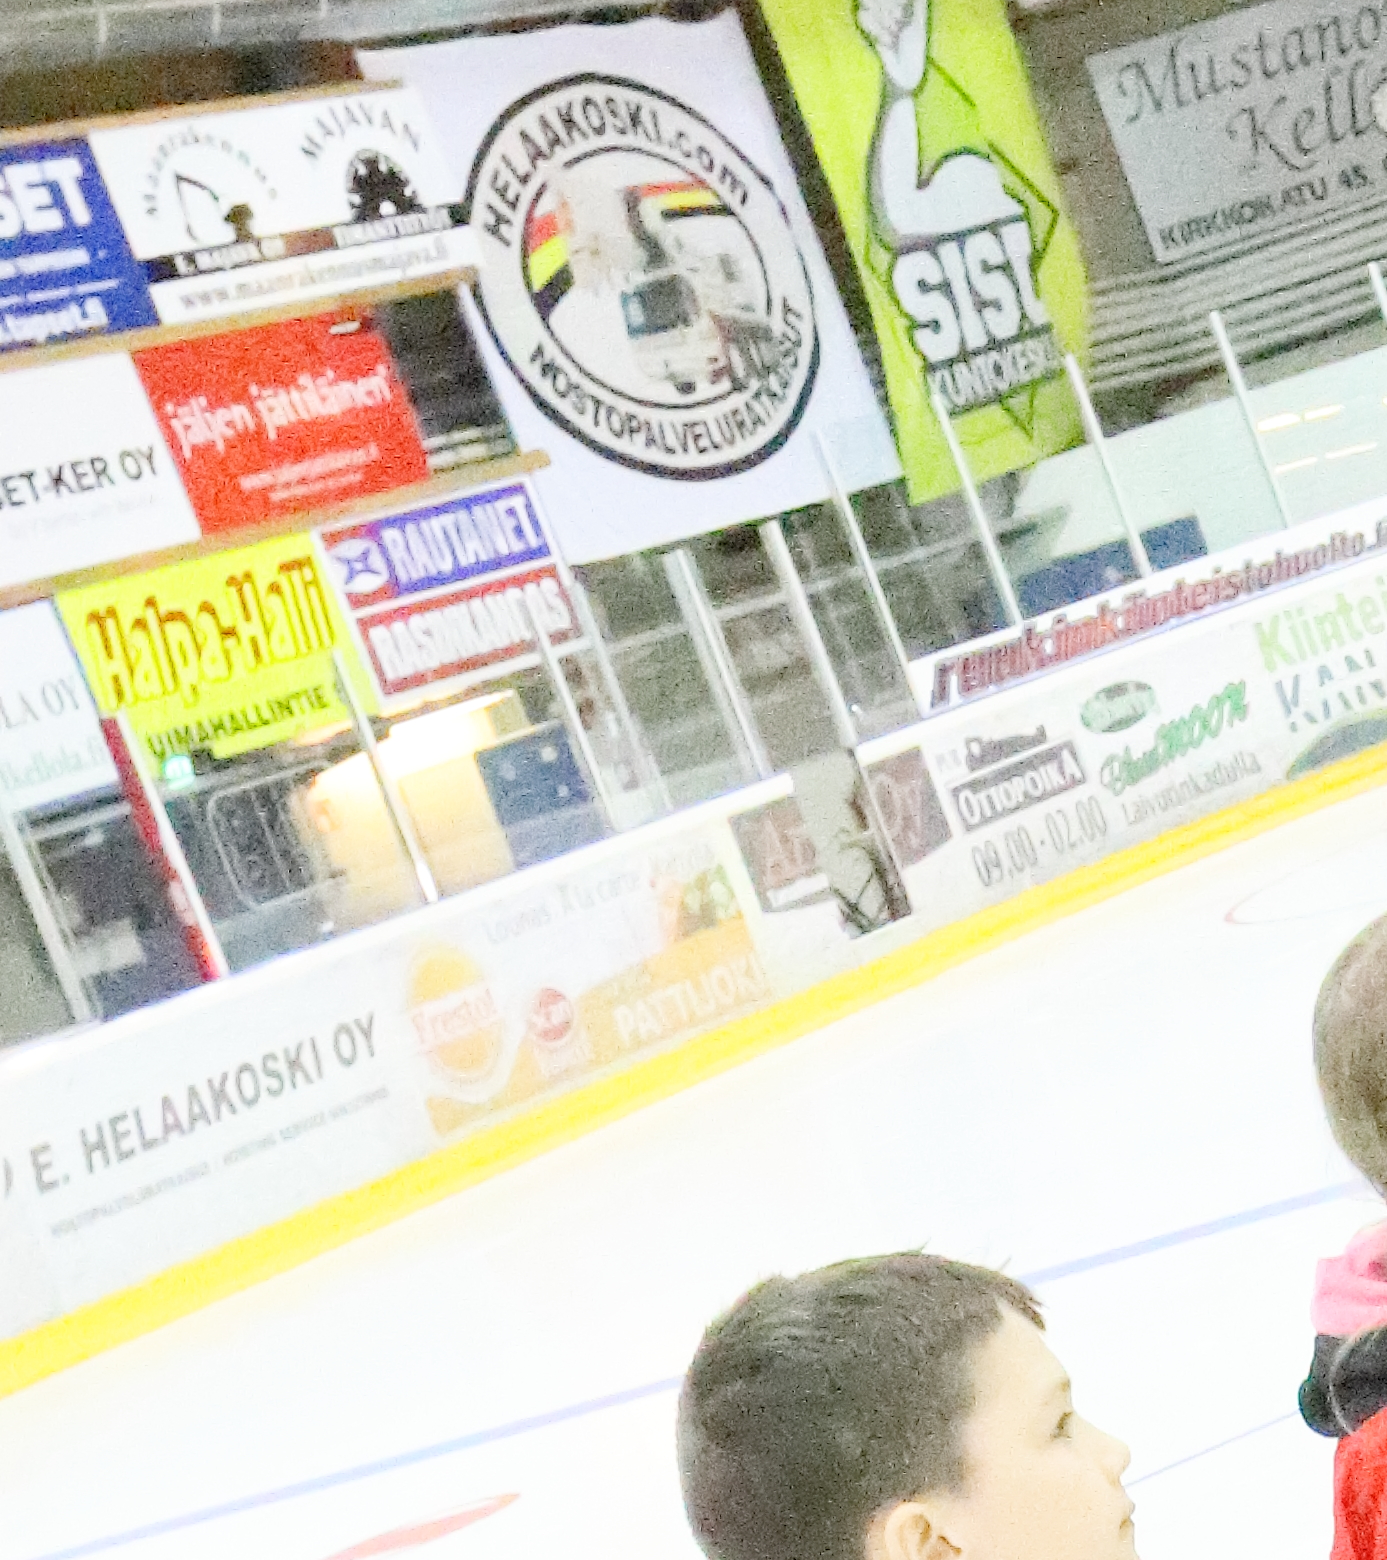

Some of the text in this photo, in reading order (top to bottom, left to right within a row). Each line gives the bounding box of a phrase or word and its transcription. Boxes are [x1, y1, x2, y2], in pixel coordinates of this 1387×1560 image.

[483, 93, 750, 249] HELAAKOSKI.com
[0, 443, 160, 512] ET-KER OY
[384, 492, 542, 584] RAUTANET
[32, 1012, 381, 1196] E. HELAAKOSKI OY
